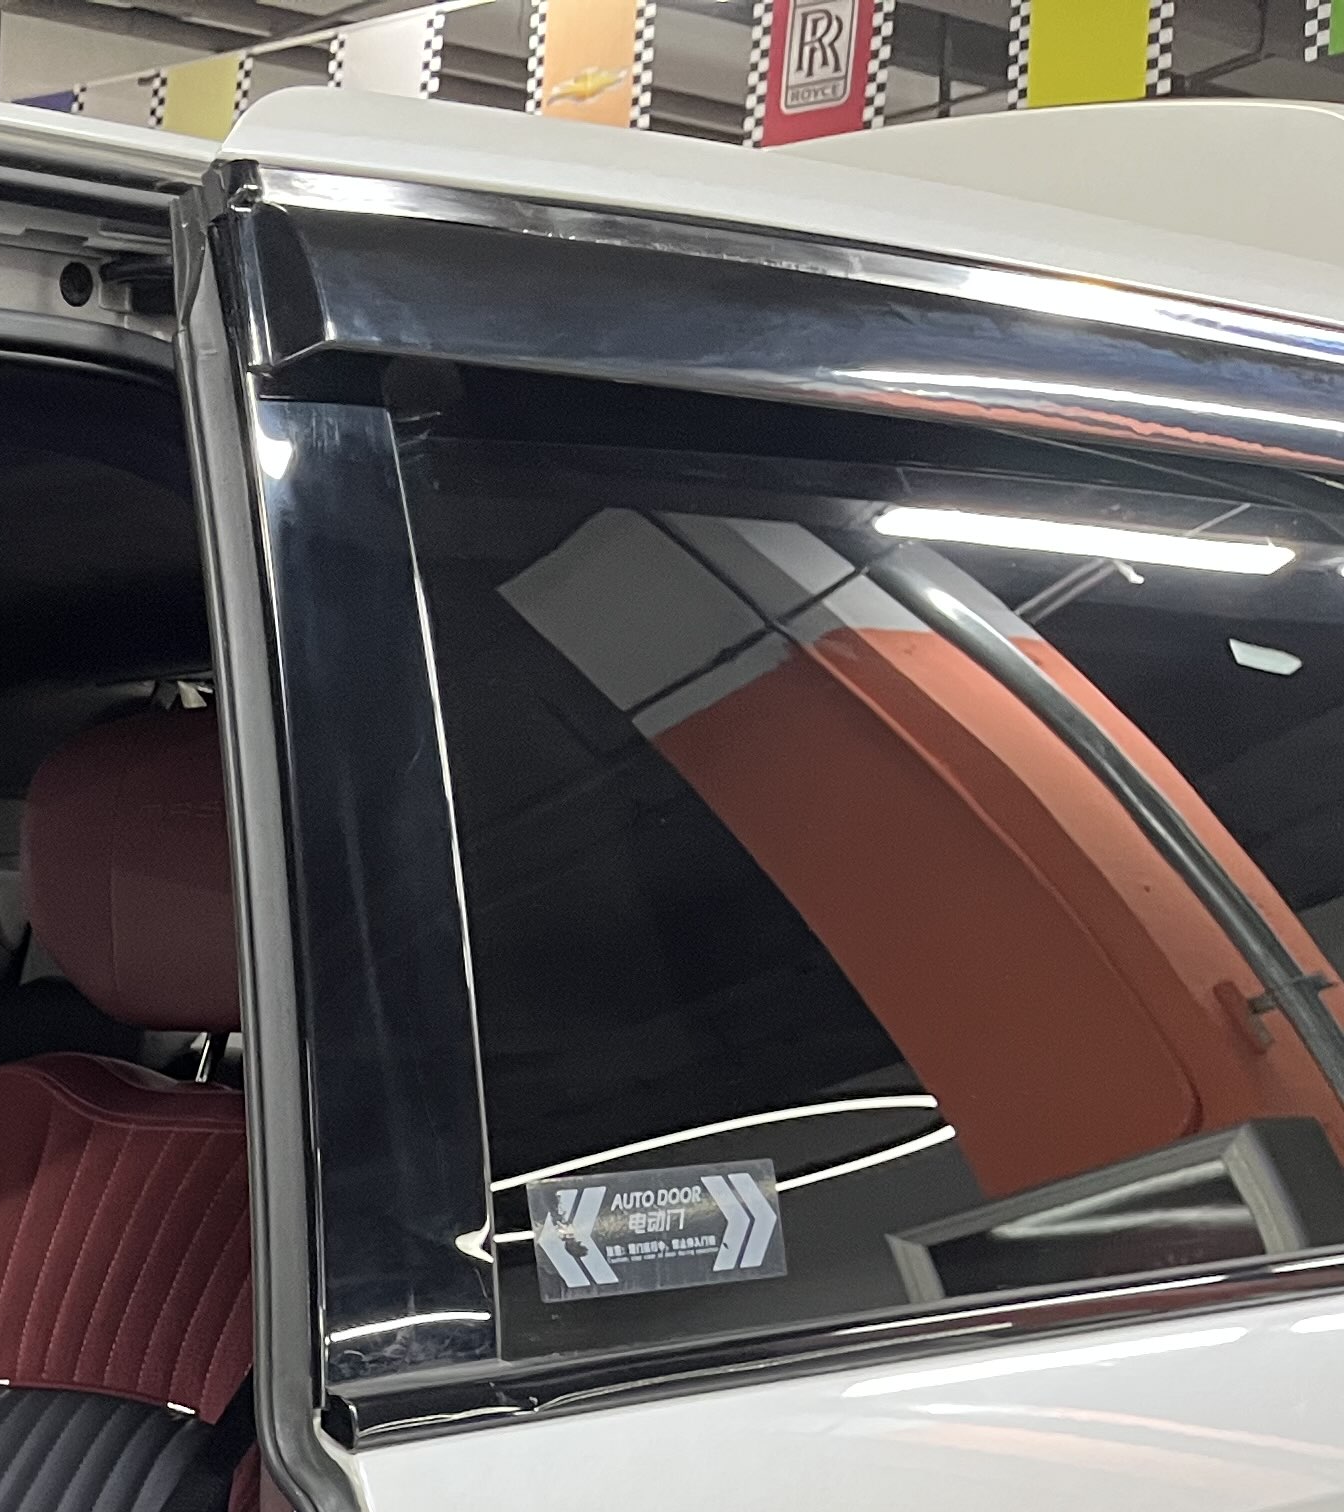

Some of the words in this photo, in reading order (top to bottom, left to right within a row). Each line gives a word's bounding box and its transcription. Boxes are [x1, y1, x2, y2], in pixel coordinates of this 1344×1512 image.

[611, 1190, 655, 1212] AUTO
[657, 1185, 702, 1205] DOOR
[628, 1208, 685, 1234] 电动门
